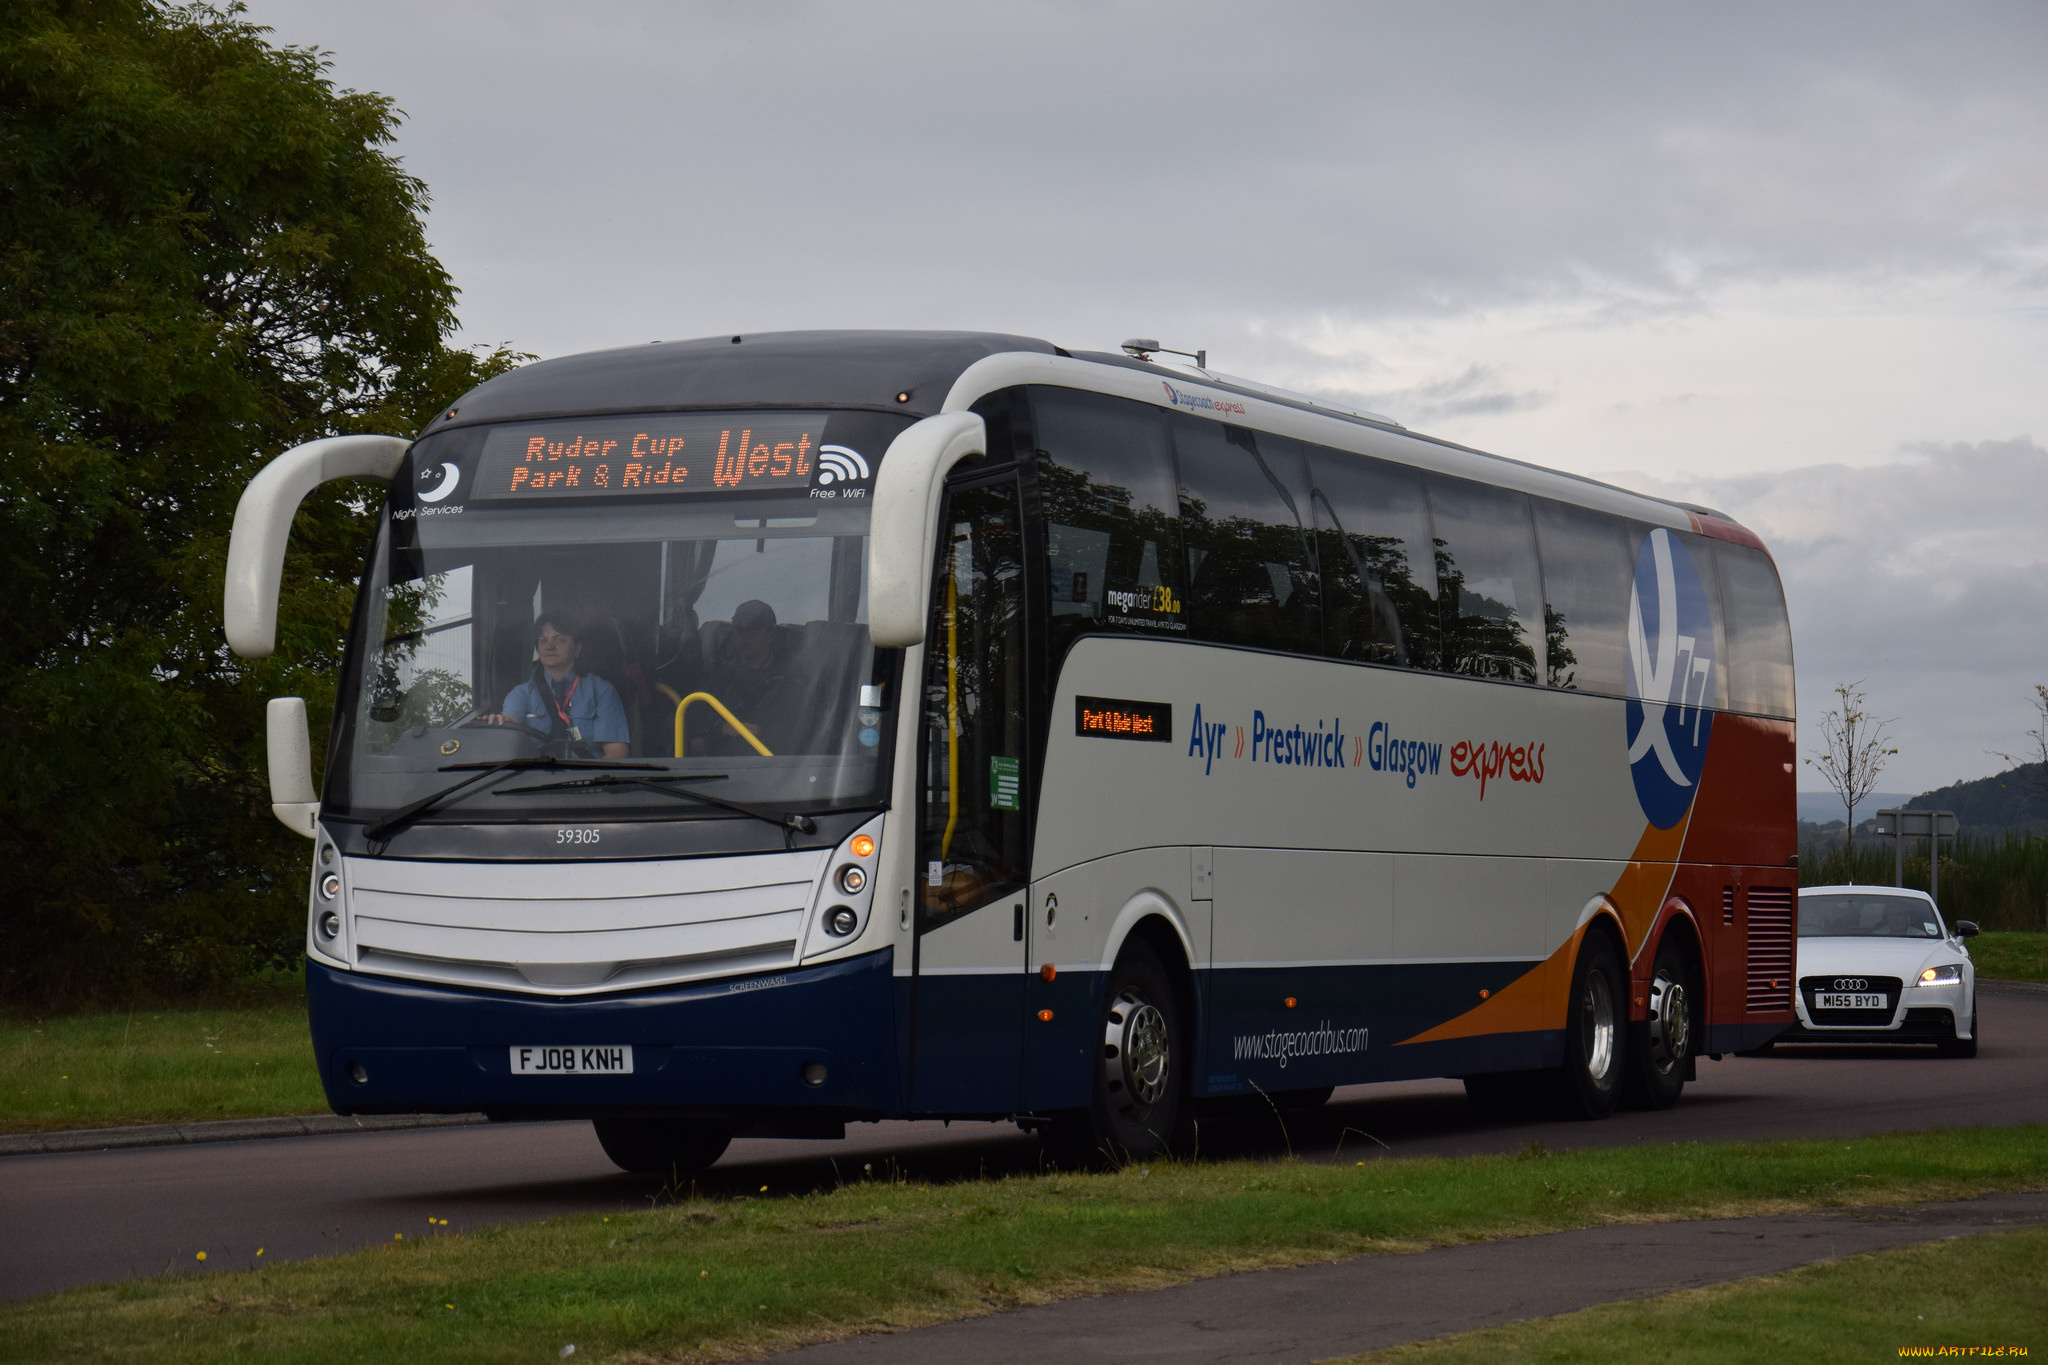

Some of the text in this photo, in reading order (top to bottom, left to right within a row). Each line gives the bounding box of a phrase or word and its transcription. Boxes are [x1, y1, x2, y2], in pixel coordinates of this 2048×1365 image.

[1214, 401, 1246, 418] express
[525, 433, 684, 462] Ryder Cup
[713, 429, 811, 487] West
[511, 462, 688, 491] Park & Ride
[809, 488, 866, 499] Free WiFi
[392, 504, 464, 520] Night Services
[1153, 585, 1180, 614] £38.00
[1083, 709, 1104, 730] Park
[1113, 712, 1132, 733] Ride
[1132, 713, 1153, 734] West
[1188, 703, 1545, 802] Ayr Prestwick Glasgow express
[556, 829, 600, 843] 59305
[728, 976, 787, 993] SCREENWASH
[1855, 995, 1880, 1007] BYD
[1234, 1019, 1369, 1069] www.stagecoachbus.com
[520, 1048, 624, 1070] FJ08 KNH
